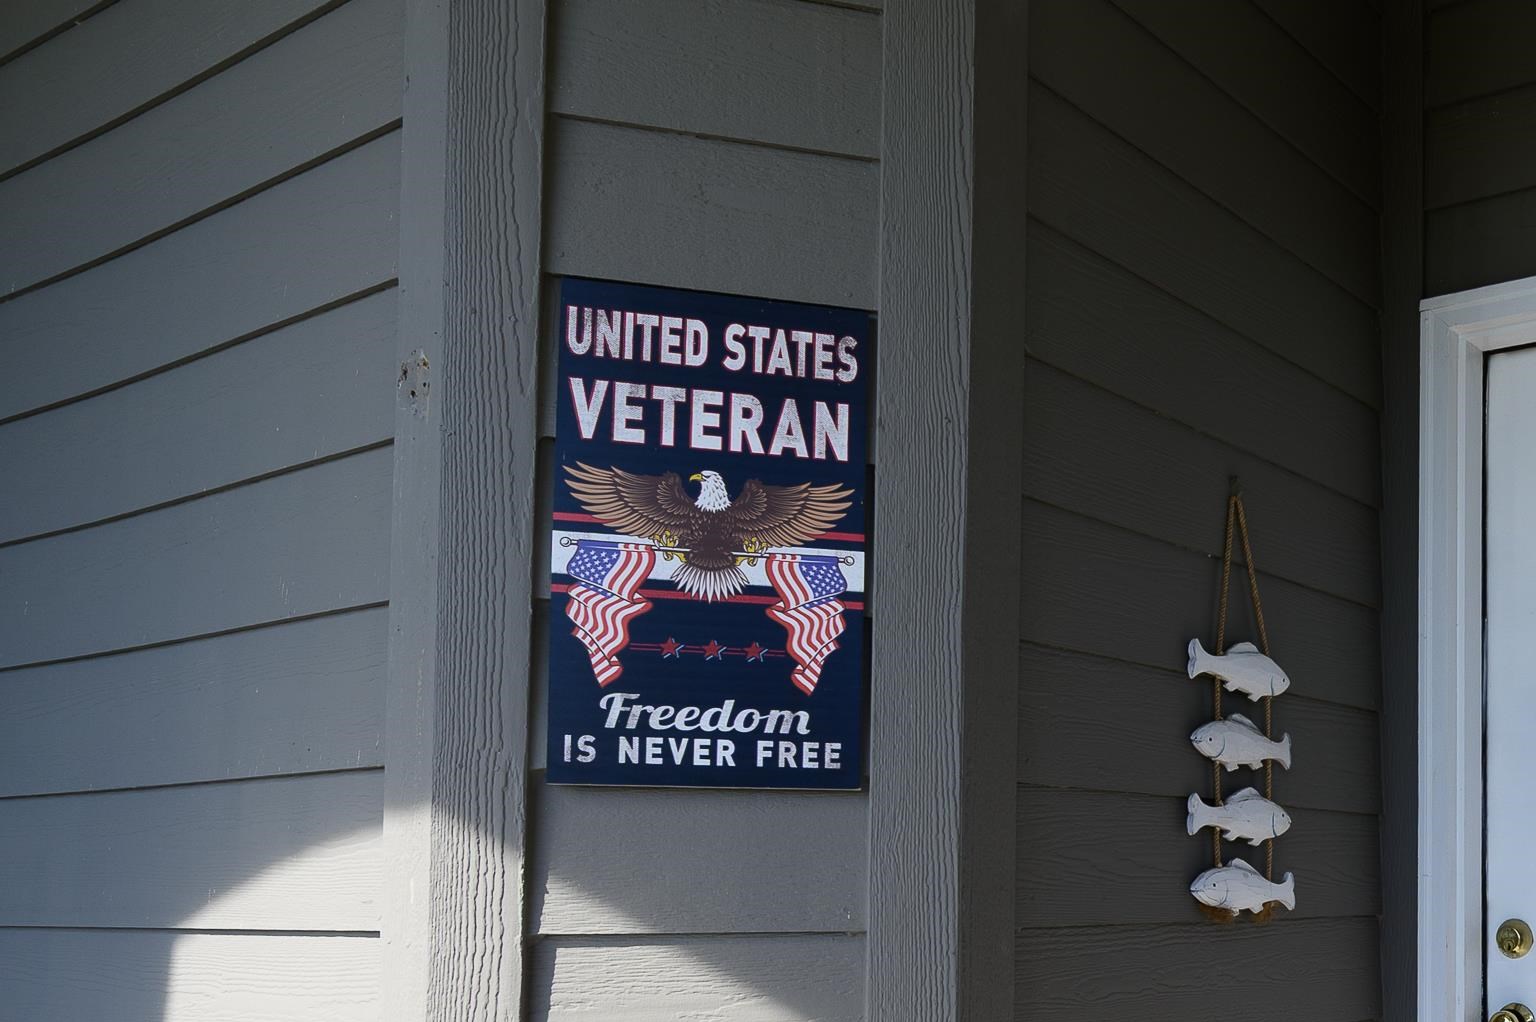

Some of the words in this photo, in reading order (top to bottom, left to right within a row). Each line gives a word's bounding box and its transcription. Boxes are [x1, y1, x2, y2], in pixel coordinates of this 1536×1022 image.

[567, 305, 709, 367] UNITED
[723, 323, 858, 382] STATES
[568, 377, 849, 462] VETERAN
[599, 692, 811, 735] Freedom
[563, 734, 597, 763] IS
[618, 736, 736, 767] NEVER
[756, 740, 842, 769] FREE
